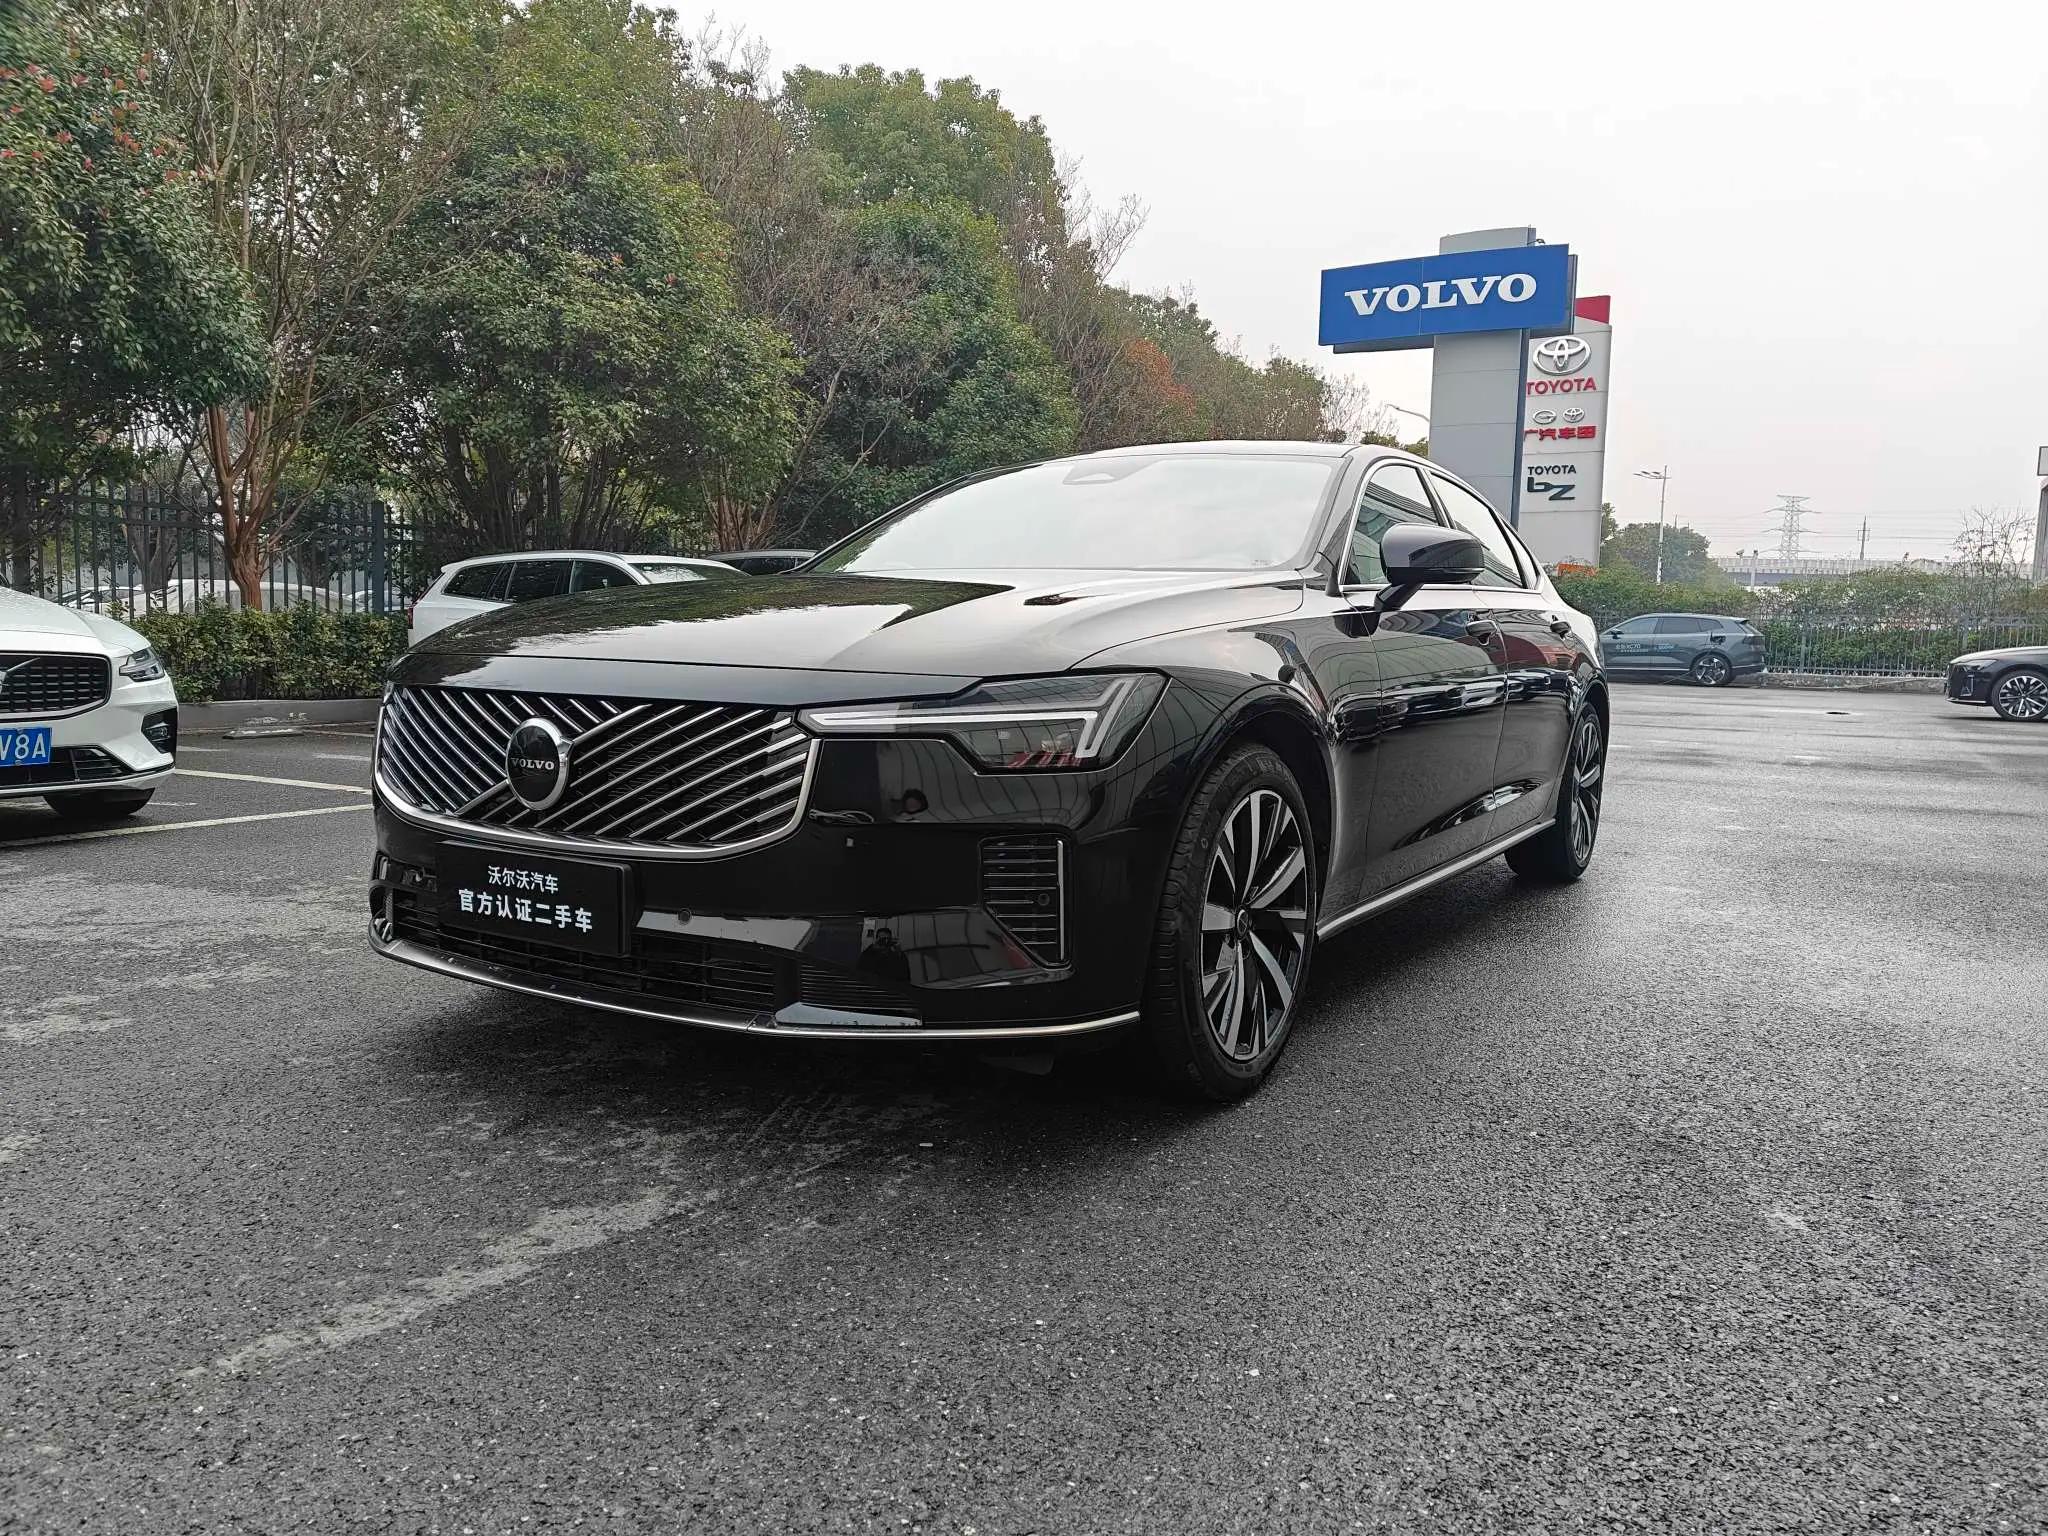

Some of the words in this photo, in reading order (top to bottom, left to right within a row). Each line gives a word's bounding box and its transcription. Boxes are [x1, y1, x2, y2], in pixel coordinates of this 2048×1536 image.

[1344, 273, 1537, 316] VOLVO
[1526, 377, 1597, 395] TOYOTA
[1527, 465, 1577, 476] TOYOTA
[510, 757, 555, 770] VOLVO
[487, 864, 559, 894] 沃尔沃汽车
[458, 888, 593, 933] 官方认证二手车
